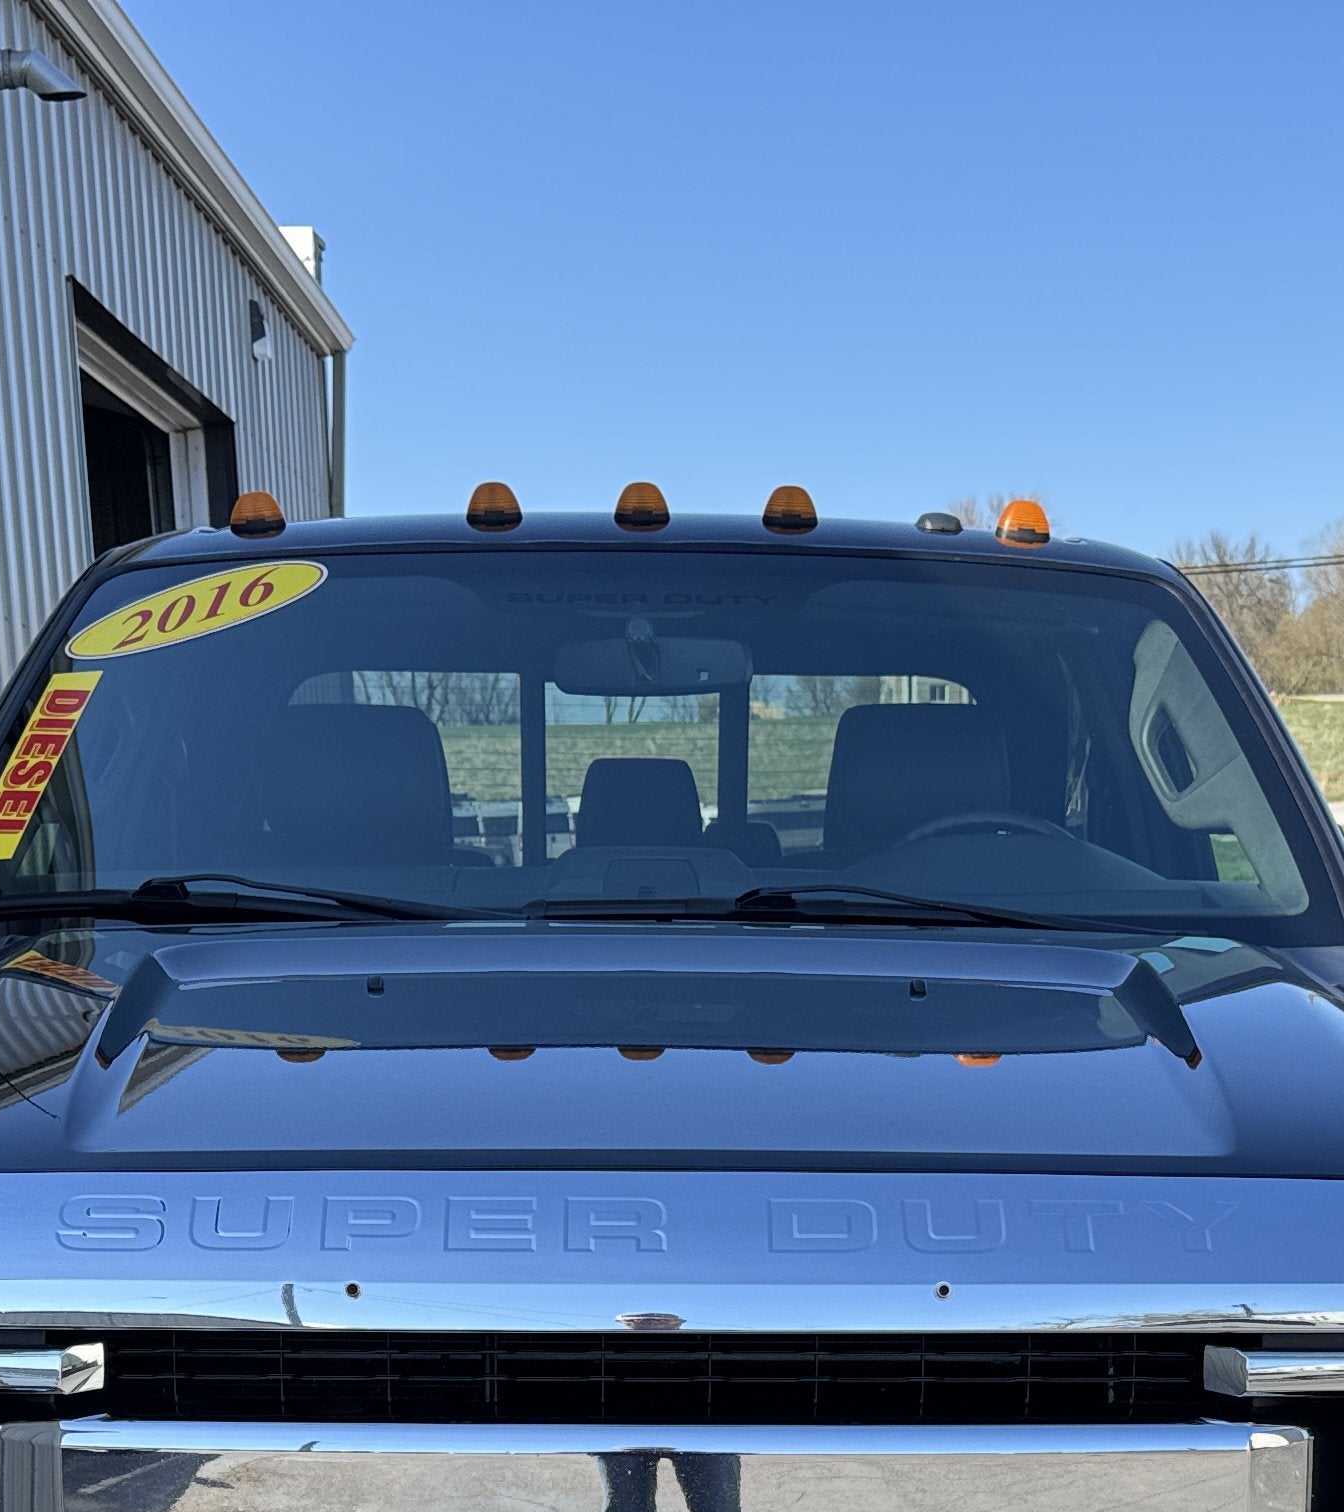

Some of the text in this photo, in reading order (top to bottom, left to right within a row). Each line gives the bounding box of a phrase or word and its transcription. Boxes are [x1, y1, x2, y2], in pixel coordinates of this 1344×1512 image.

[112, 567, 280, 650] 2016
[507, 592, 779, 605] SUPER DUTY
[56, 1194, 1243, 1254] SUPER DUTY
